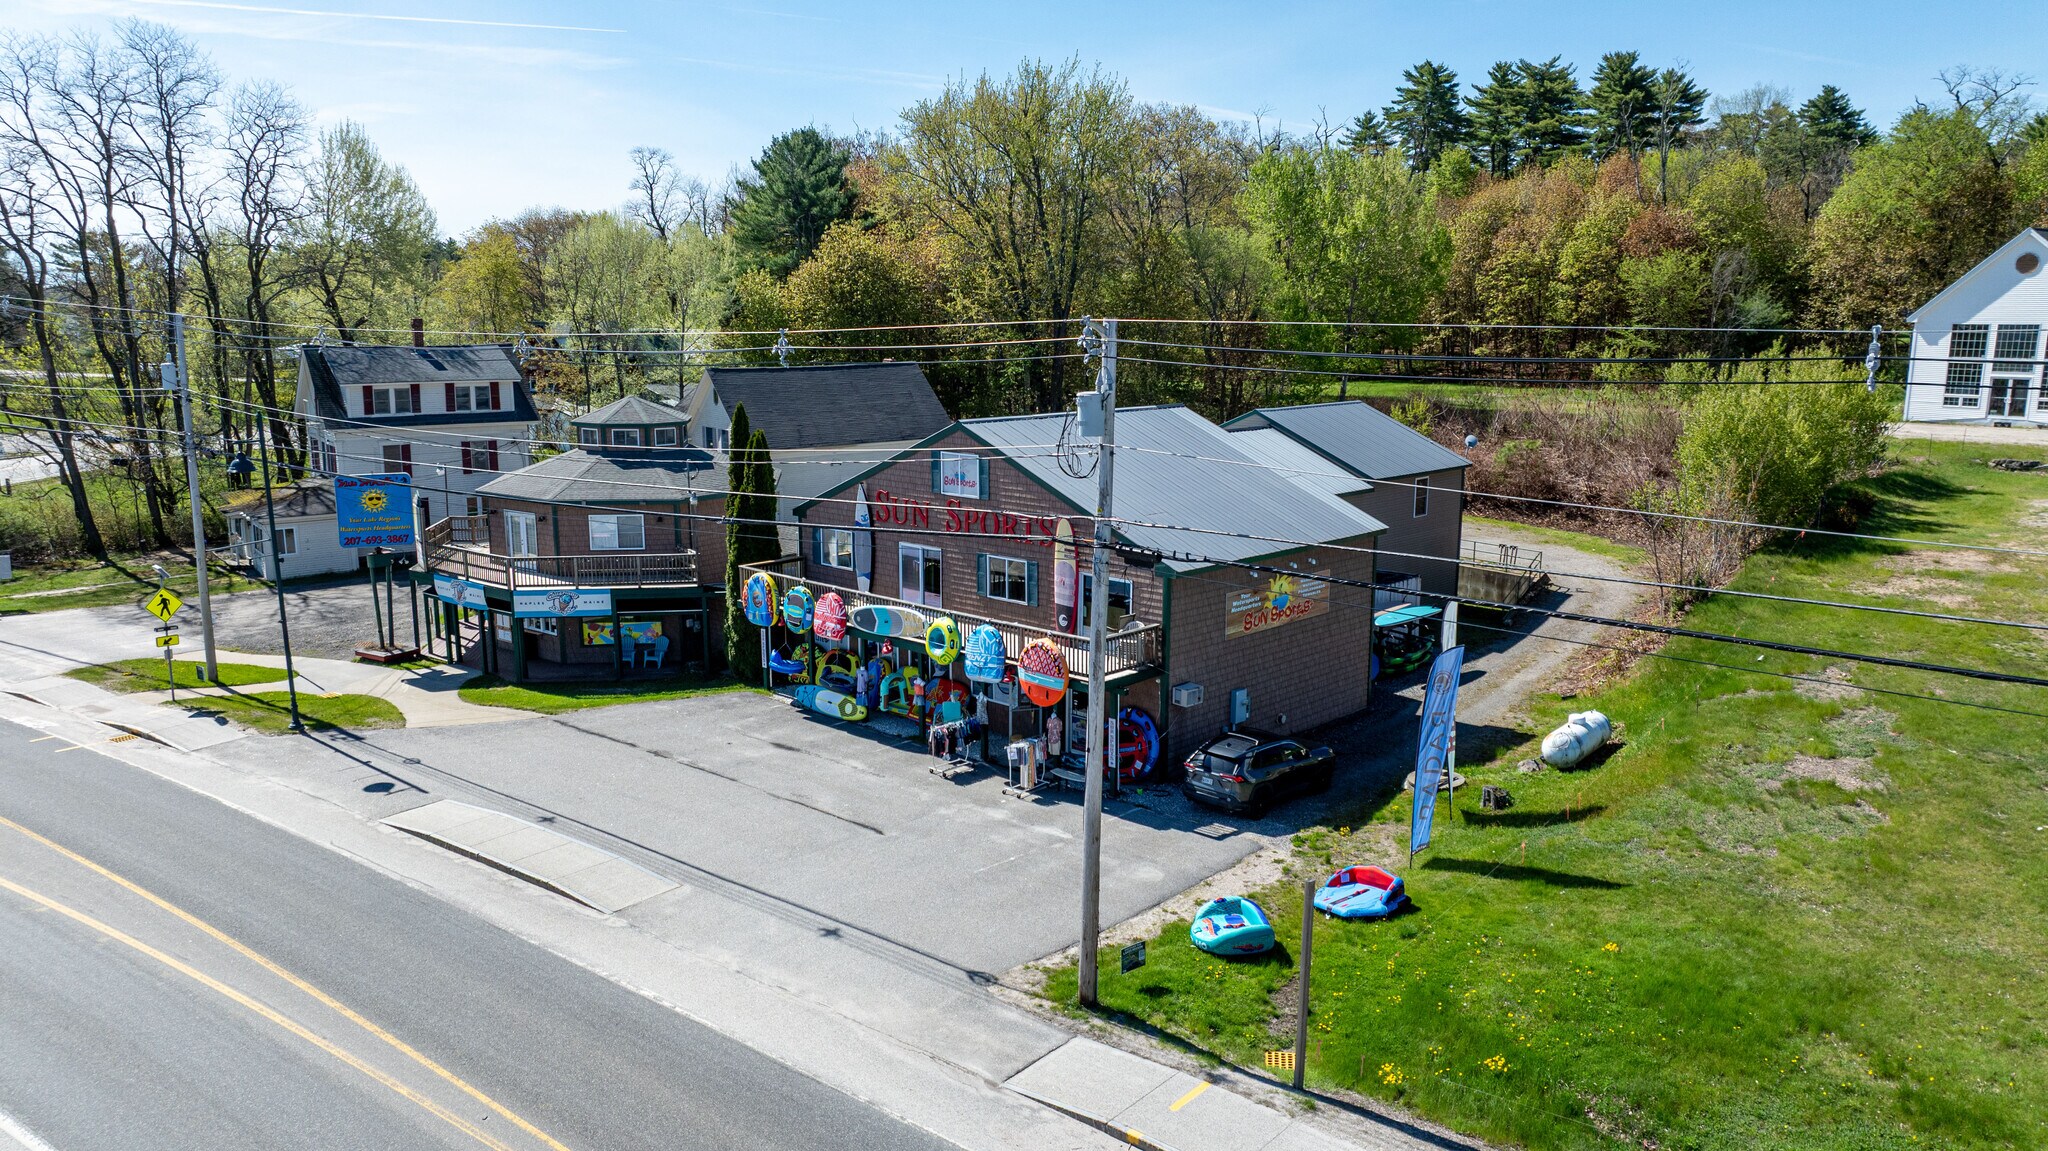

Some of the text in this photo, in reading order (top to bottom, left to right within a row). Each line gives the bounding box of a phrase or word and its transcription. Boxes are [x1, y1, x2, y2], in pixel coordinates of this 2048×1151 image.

[875, 489, 1055, 547] SUN SPORTS
[343, 533, 410, 546] 207-693-3867
